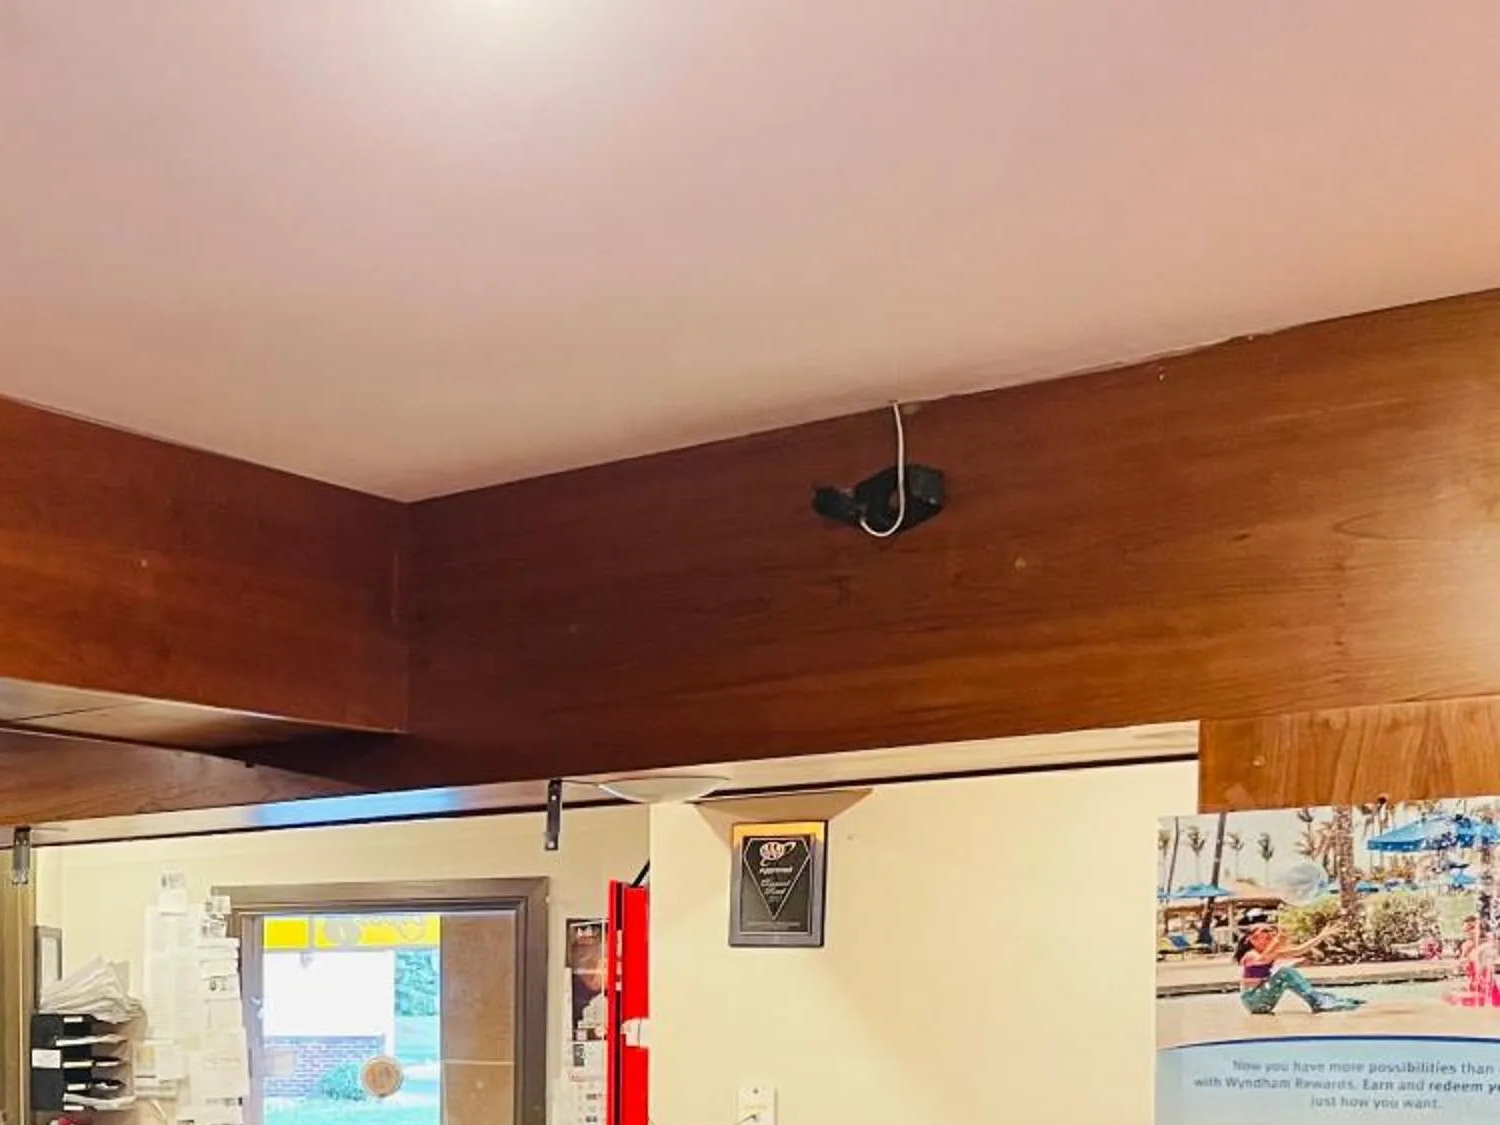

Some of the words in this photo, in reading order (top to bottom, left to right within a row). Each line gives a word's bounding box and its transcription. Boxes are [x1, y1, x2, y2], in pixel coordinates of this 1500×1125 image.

[1233, 1060, 1261, 1071] Now
[1265, 1063, 1289, 1073] you
[1293, 1061, 1325, 1072] have
[1329, 1063, 1364, 1072] more
[1368, 1061, 1457, 1074] possibilities
[1461, 1062, 1494, 1074] than
[1194, 1077, 1222, 1088] with
[1226, 1078, 1290, 1089] Wyndham
[1363, 1078, 1393, 1090] Earn
[1398, 1080, 1425, 1091] and
[1430, 1081, 1483, 1093] redeem
[1340, 1097, 1369, 1107] how
[1373, 1098, 1399, 1109] you
